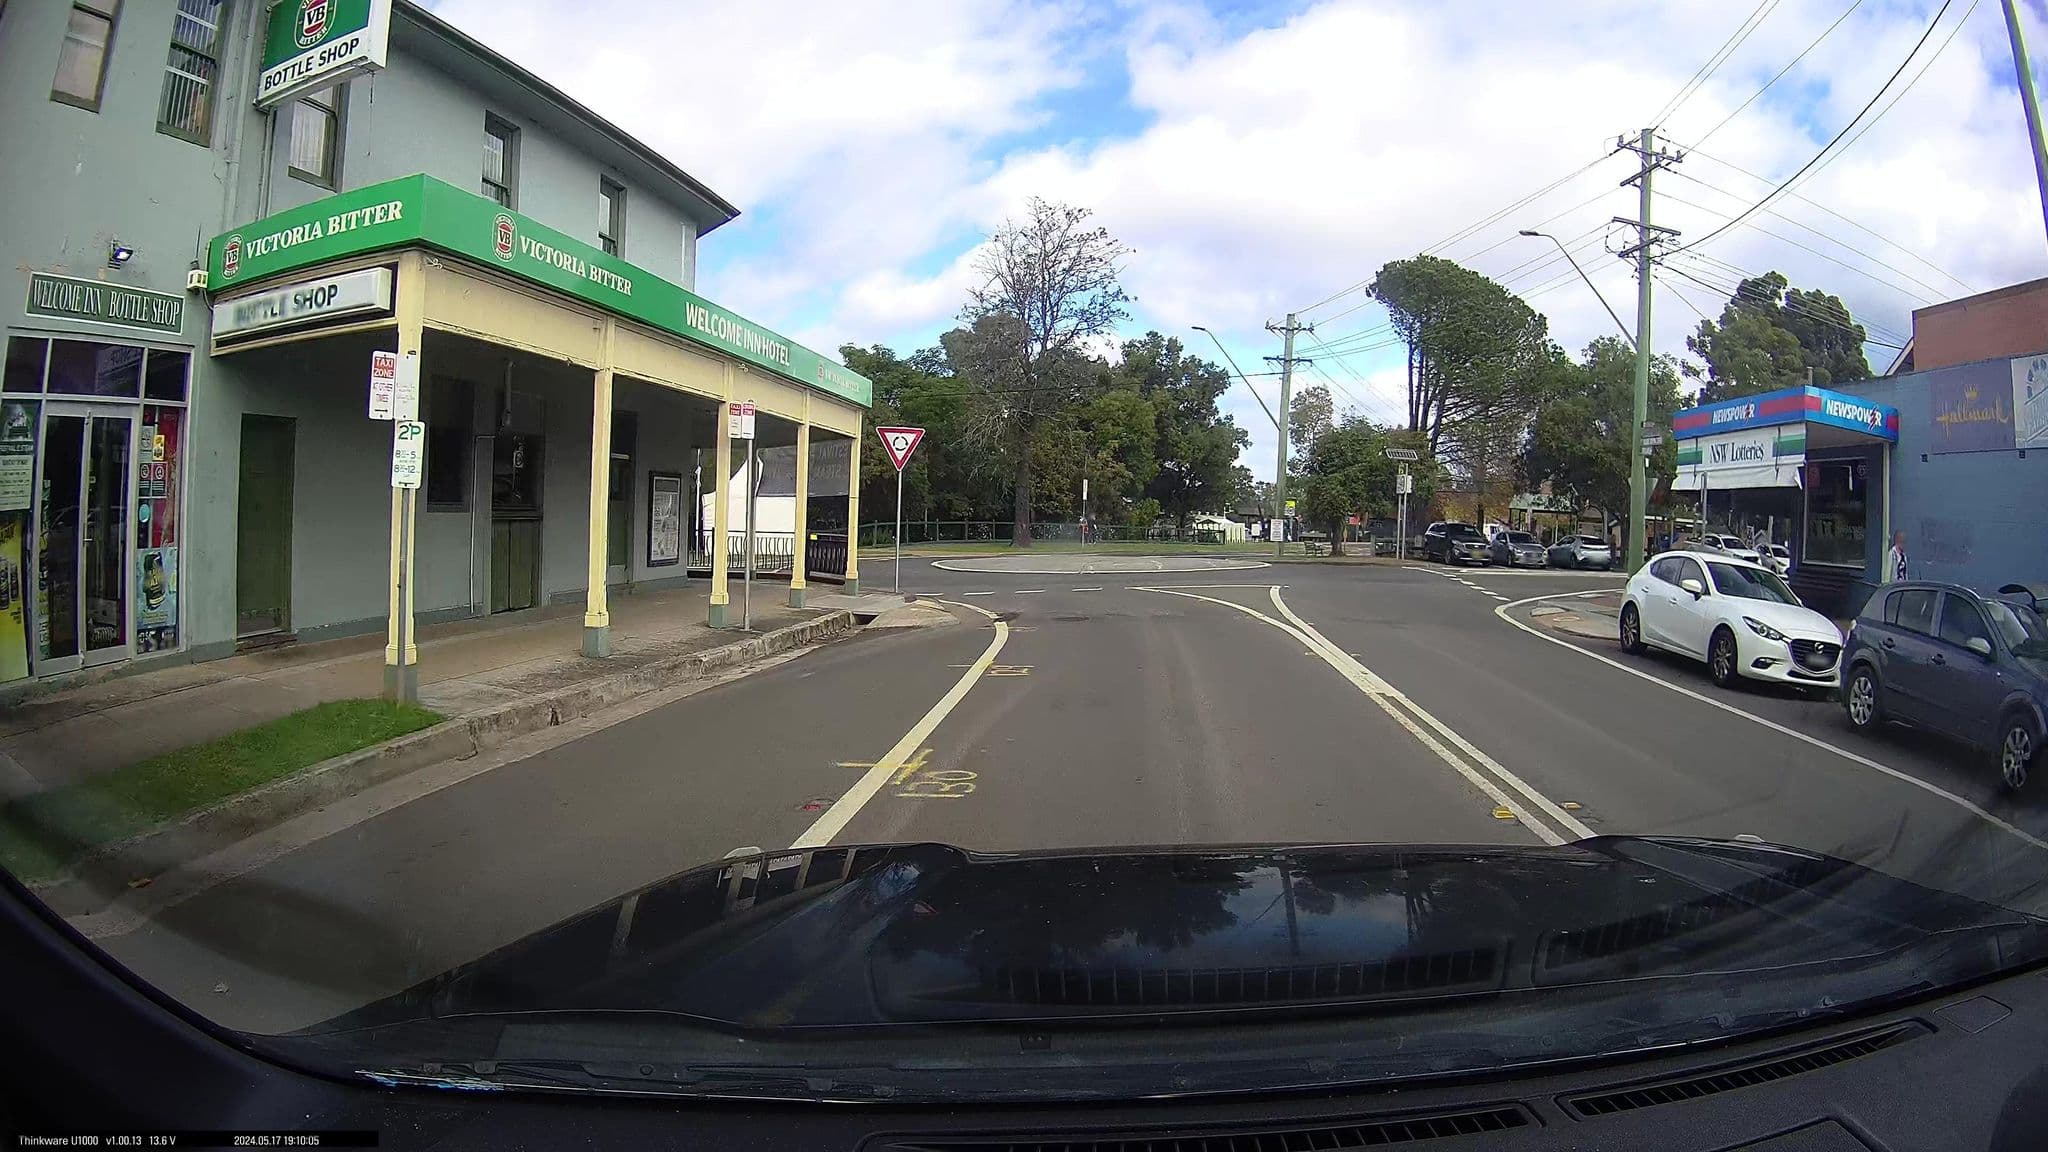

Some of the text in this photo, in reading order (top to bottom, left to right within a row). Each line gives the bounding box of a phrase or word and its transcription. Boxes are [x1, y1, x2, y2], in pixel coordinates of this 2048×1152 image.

[306, 5, 326, 26] VB
[264, 37, 359, 91] BOTTLE SHOP
[246, 200, 403, 259] VICTORIA BITTER
[520, 235, 633, 296] VICTORIA BITTER
[33, 279, 180, 326] WELCOME INN BOTTLE SHOP
[293, 284, 338, 310] SHOP
[686, 301, 790, 367] WELCOME INN HOTEL
[374, 368, 394, 378] ZONE
[375, 358, 394, 368] TAXI
[399, 424, 421, 440] 2P
[1710, 440, 1764, 464] NSW Lotteries
